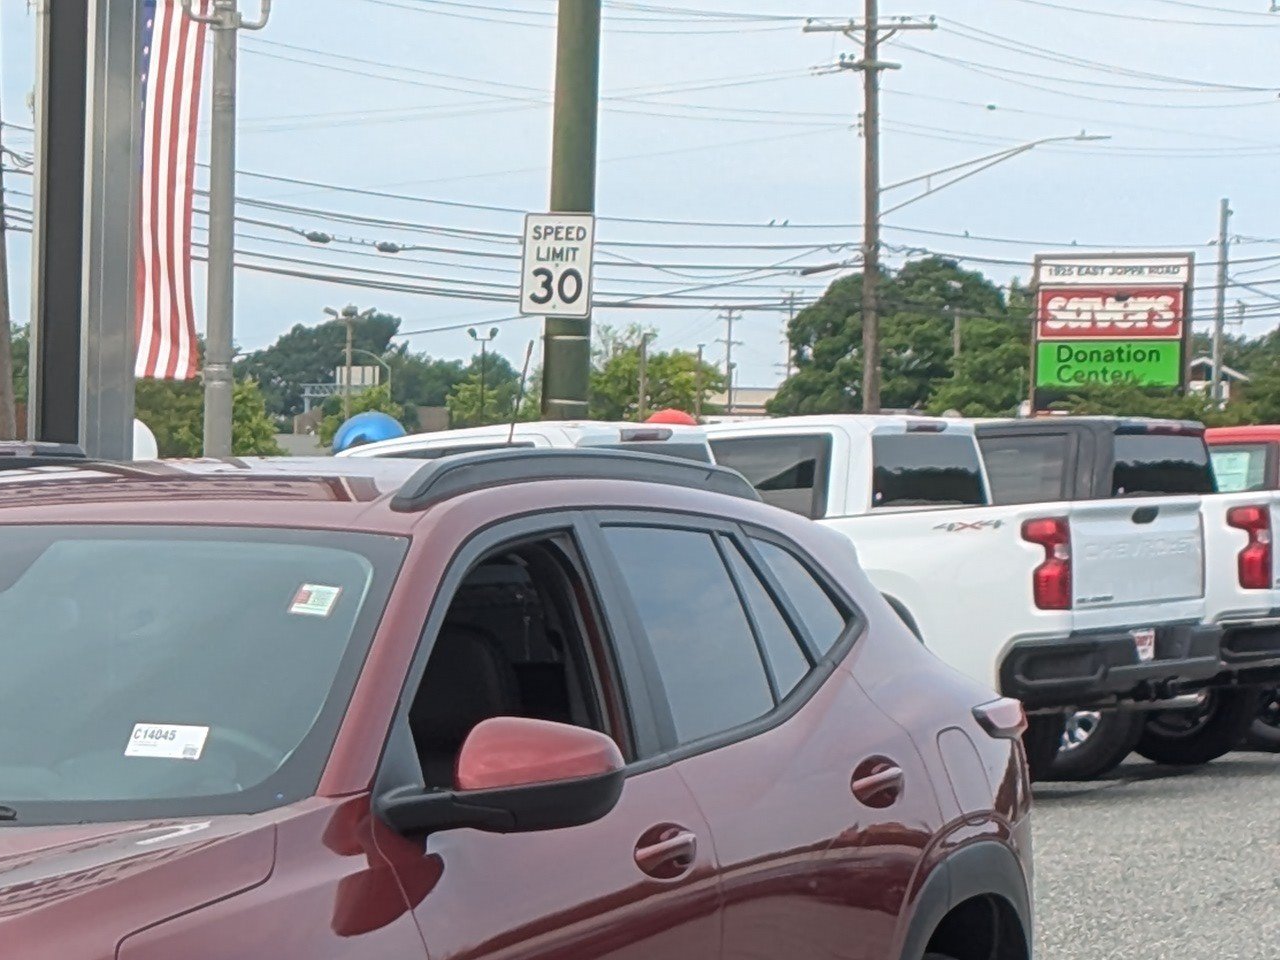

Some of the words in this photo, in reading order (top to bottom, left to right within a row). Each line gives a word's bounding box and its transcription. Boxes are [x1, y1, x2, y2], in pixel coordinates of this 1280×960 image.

[532, 225, 587, 241] SPEED
[536, 246, 579, 262] LIMIT
[1077, 265, 1106, 276] EAST
[1108, 265, 1145, 276] JOPPA
[1148, 264, 1181, 275] ROAD
[529, 267, 583, 304] 30
[1056, 344, 1161, 363] Donation
[1056, 364, 1133, 384] Center
[133, 728, 177, 742] C14045
